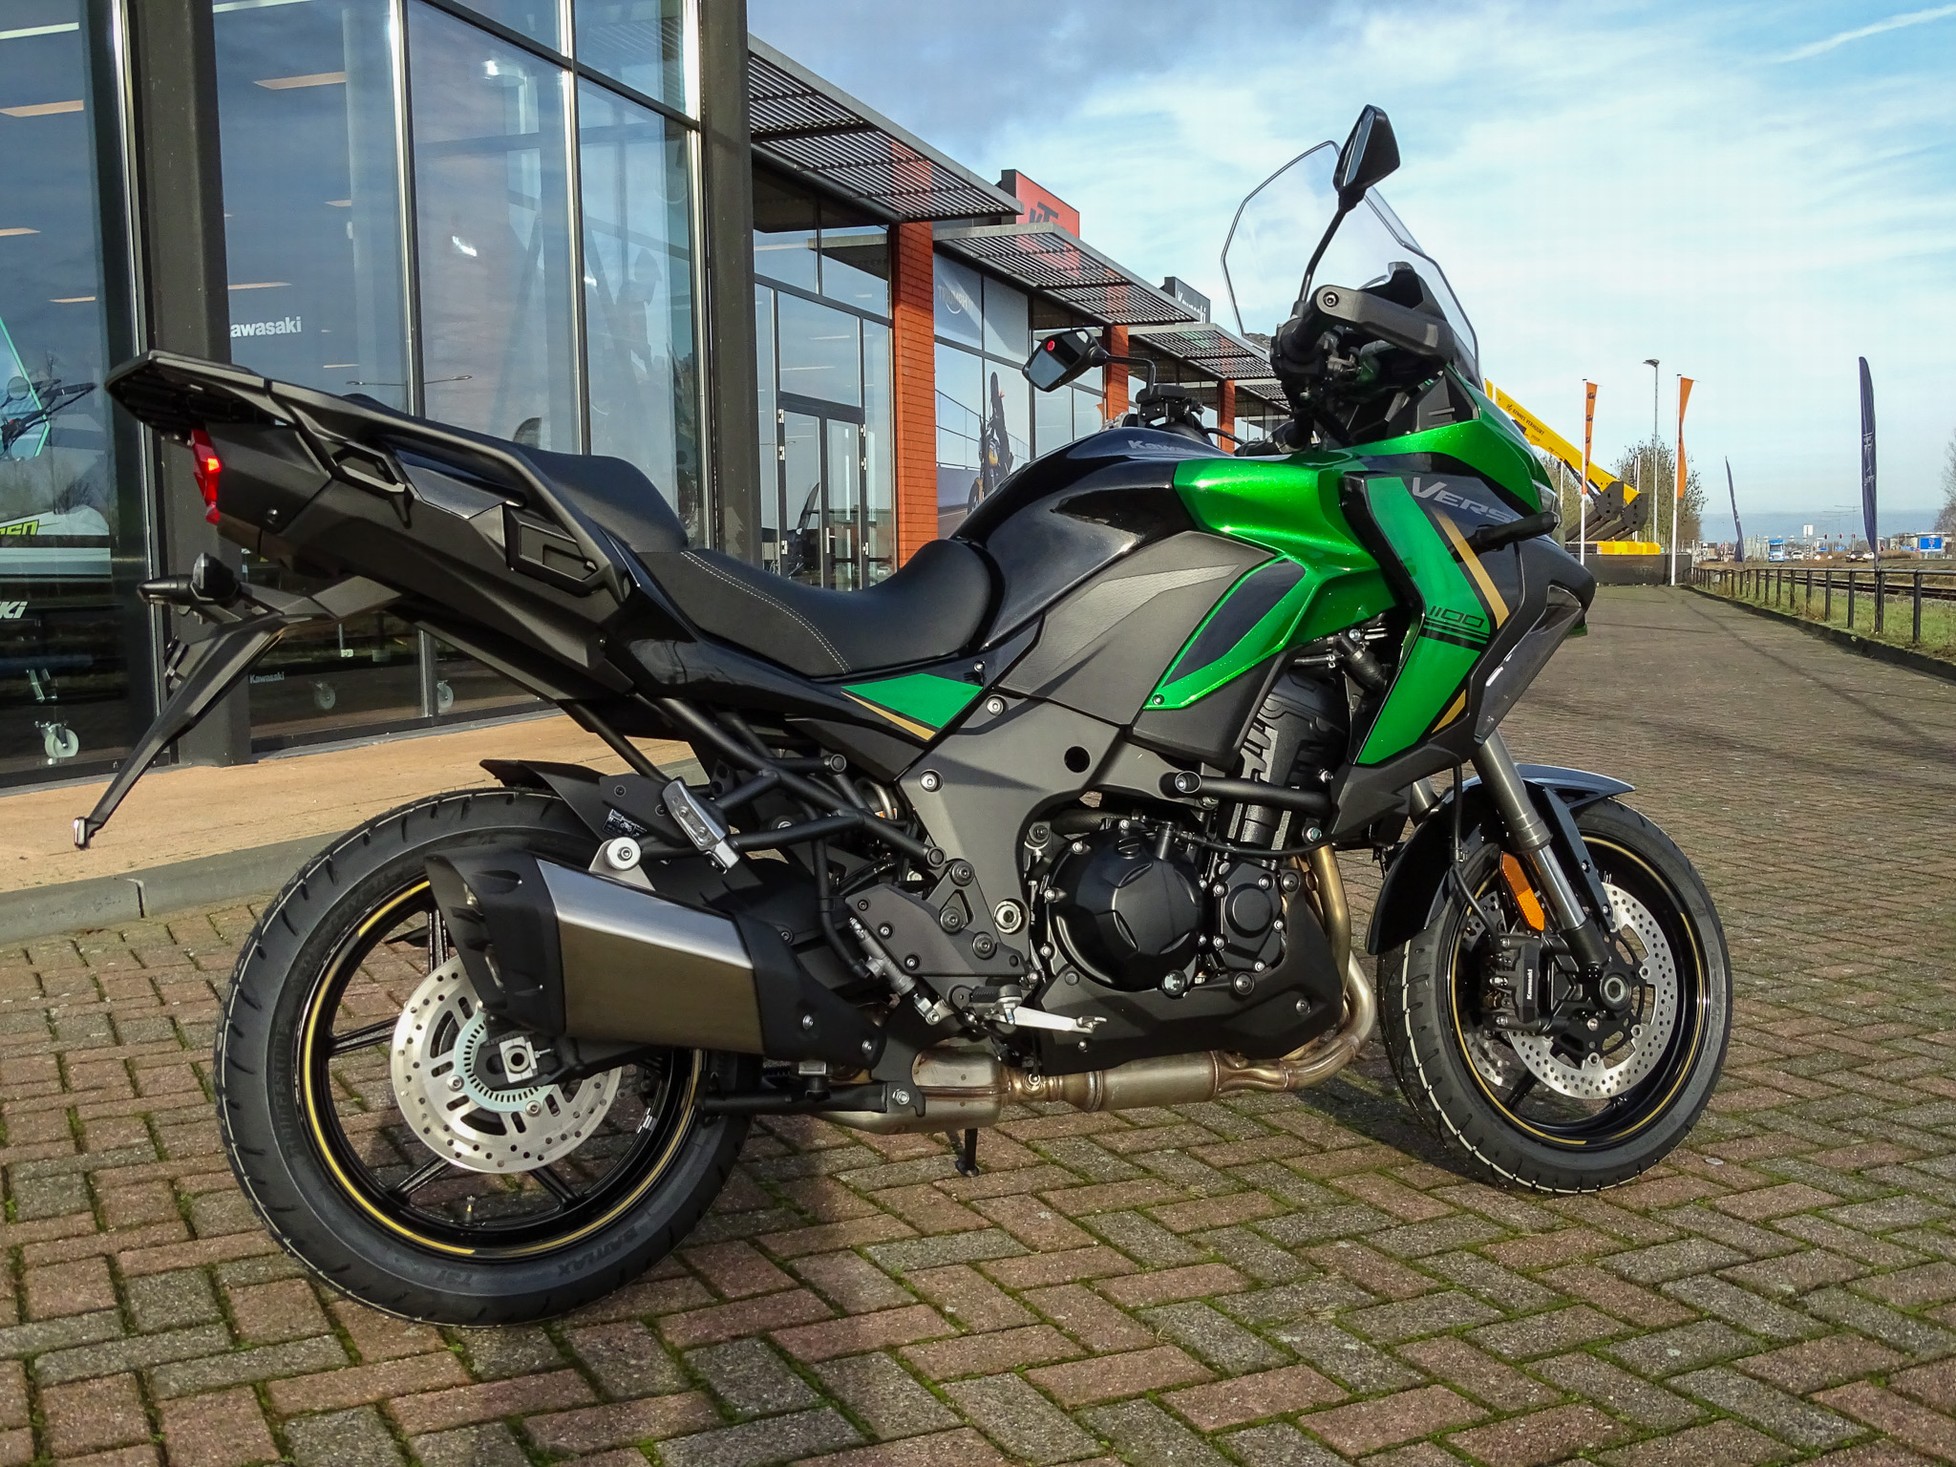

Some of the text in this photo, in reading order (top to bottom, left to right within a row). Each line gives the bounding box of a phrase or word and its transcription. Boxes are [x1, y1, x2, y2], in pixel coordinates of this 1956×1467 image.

[230, 316, 302, 337] awasaki
[1412, 477, 1522, 523] VERS
[0, 601, 29, 619] Ki
[1429, 605, 1485, 628] 1100
